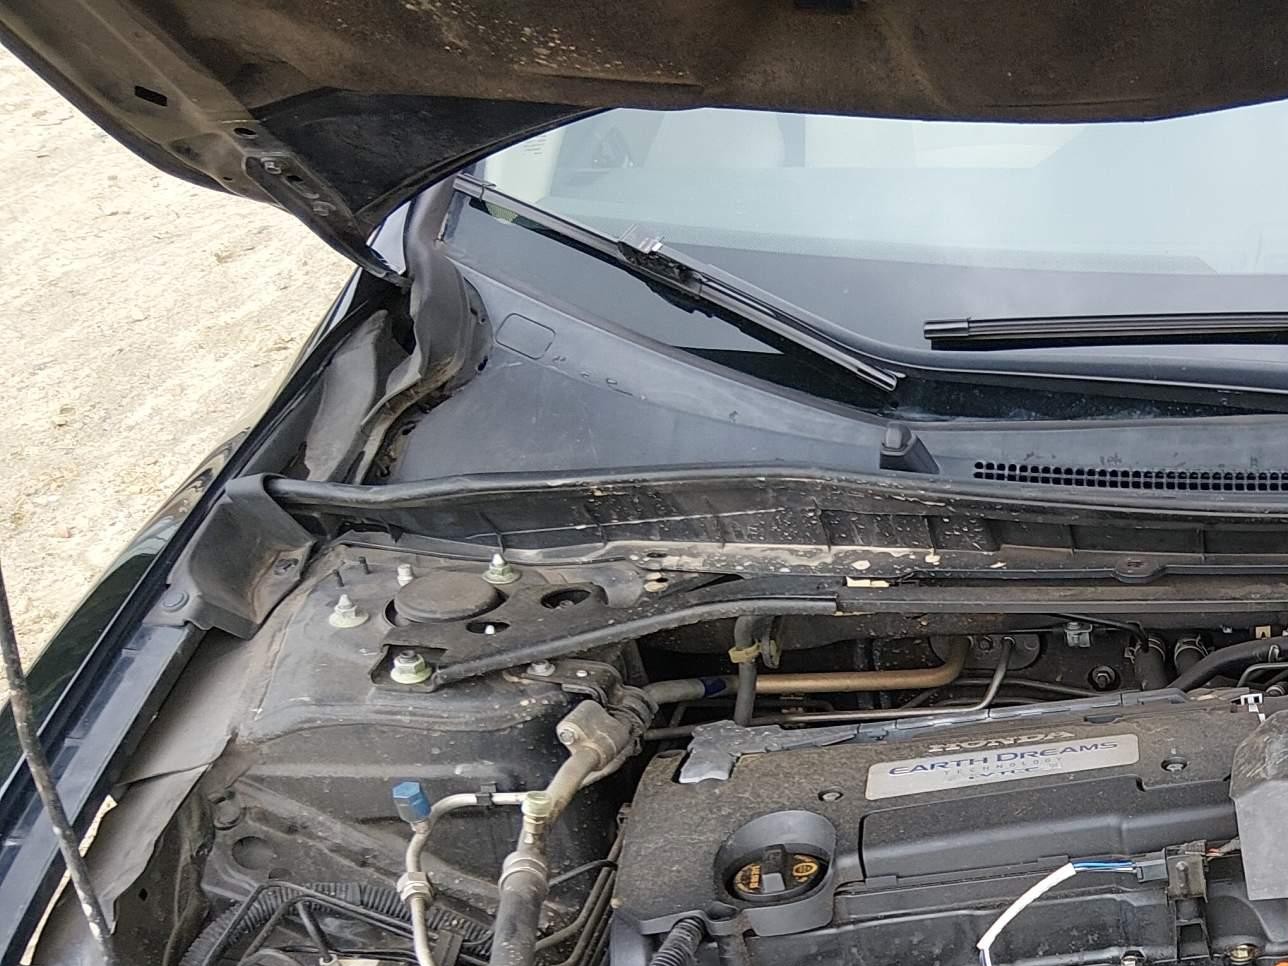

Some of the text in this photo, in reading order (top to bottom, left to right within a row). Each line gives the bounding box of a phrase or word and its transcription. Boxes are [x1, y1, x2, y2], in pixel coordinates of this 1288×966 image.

[928, 731, 1075, 753] HONDA
[889, 740, 1119, 776] EARTH DREAMS
